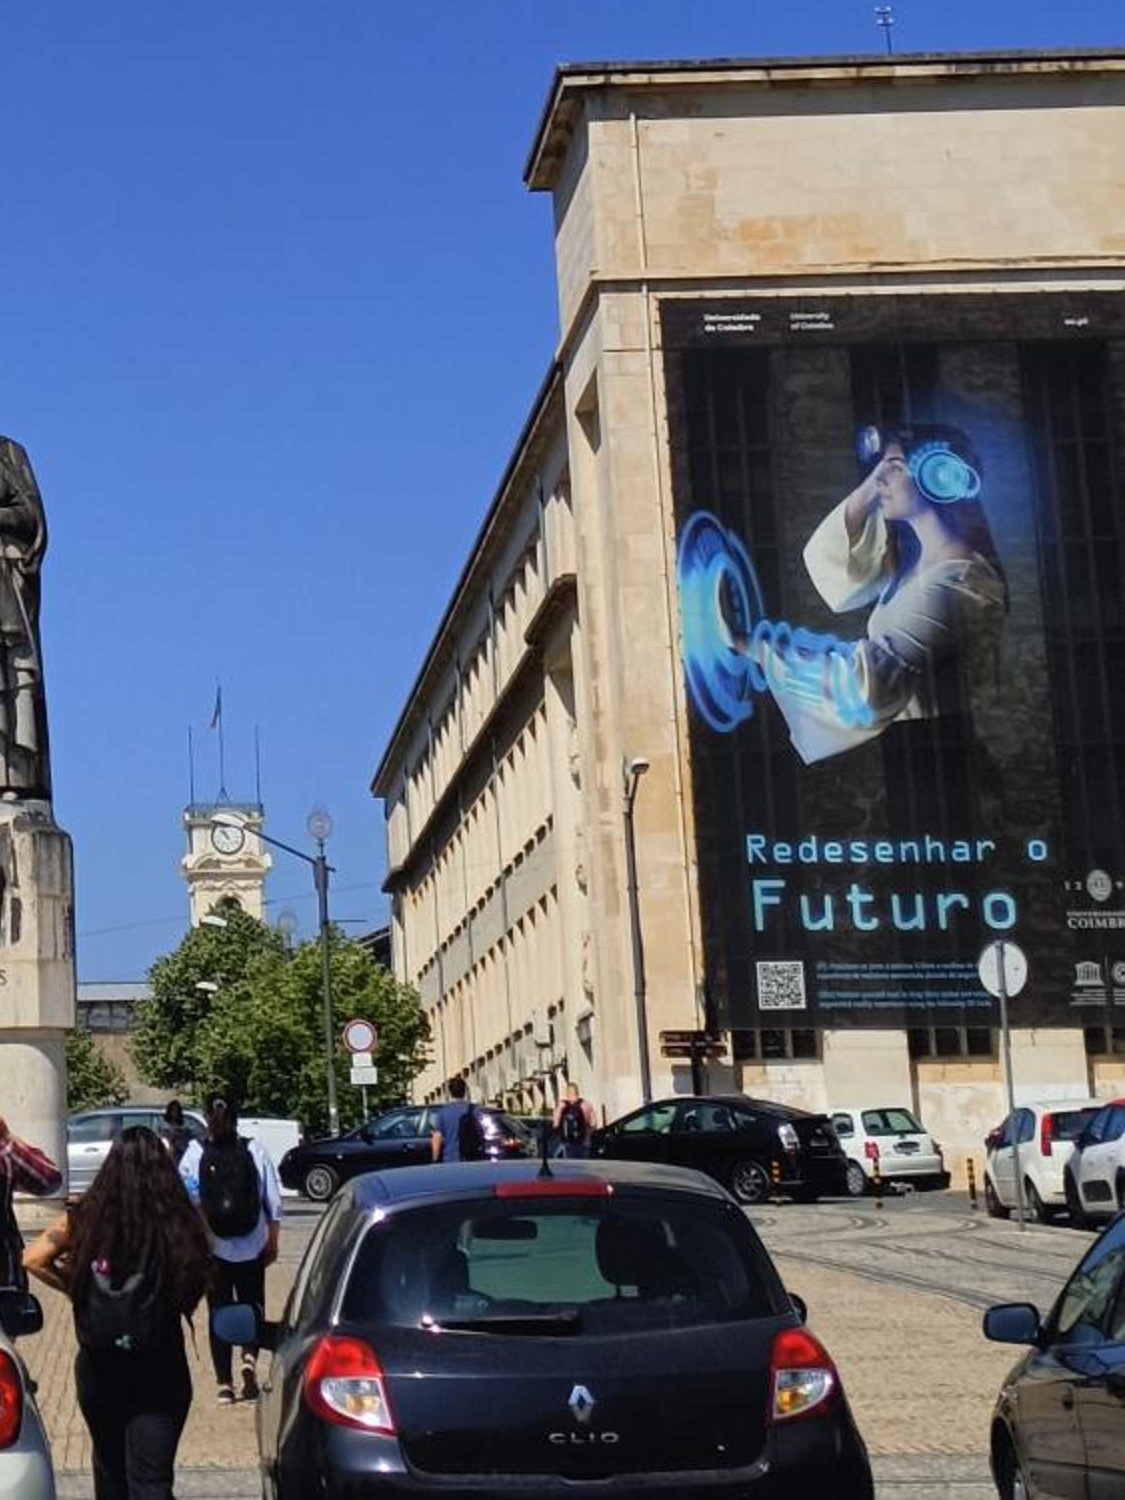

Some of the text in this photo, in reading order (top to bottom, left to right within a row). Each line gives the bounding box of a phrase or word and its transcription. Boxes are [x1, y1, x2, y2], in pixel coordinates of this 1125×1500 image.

[746, 834, 1048, 863] Redesenhar o
[752, 879, 1017, 931] Futuro
[1067, 917, 1125, 929] COIMBR
[549, 1432, 619, 1443] CLIO
